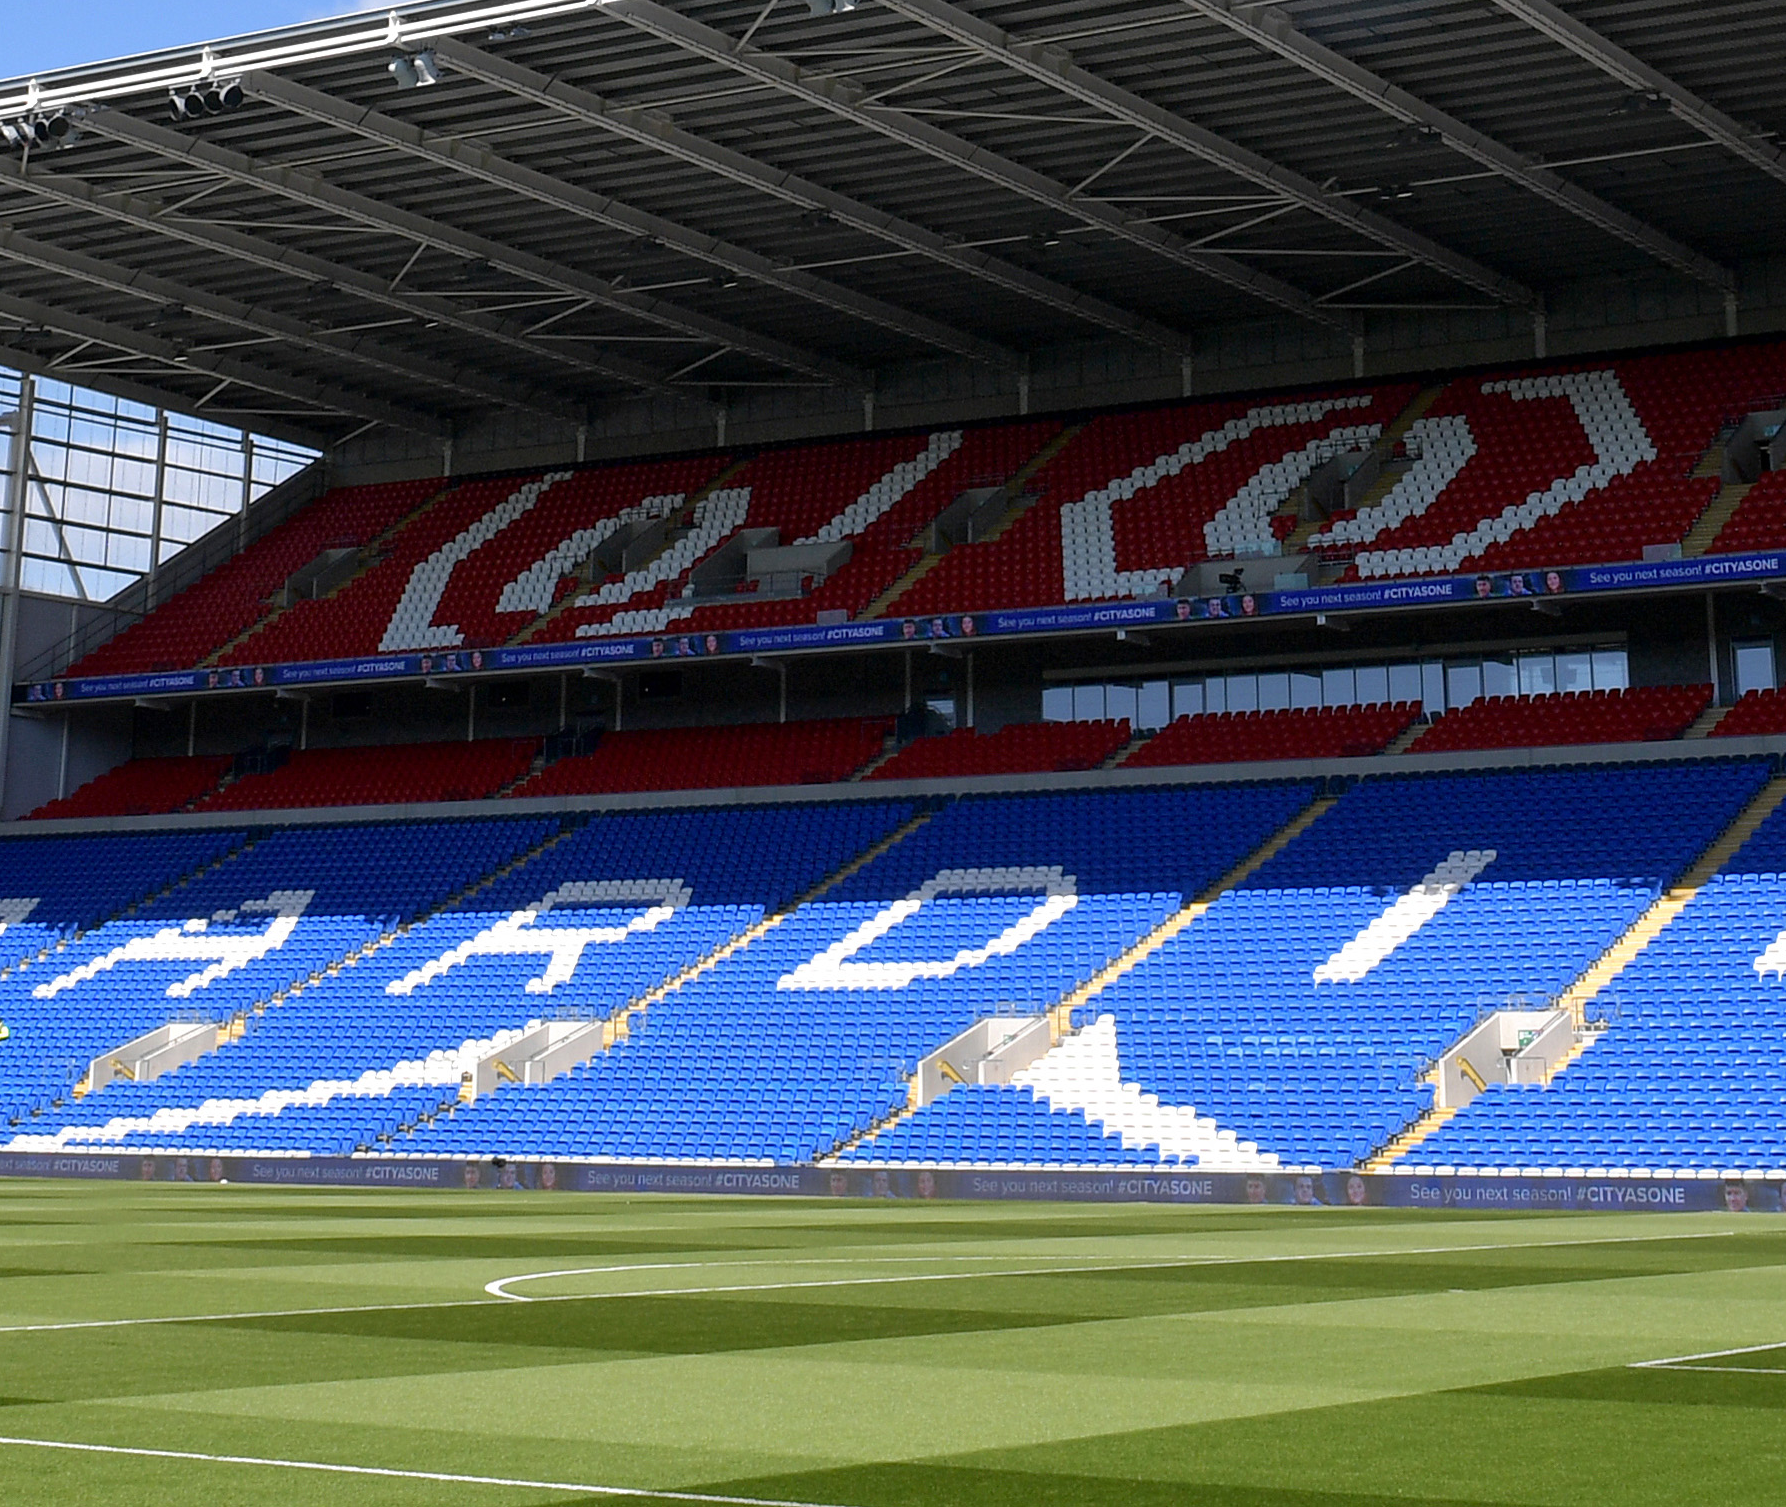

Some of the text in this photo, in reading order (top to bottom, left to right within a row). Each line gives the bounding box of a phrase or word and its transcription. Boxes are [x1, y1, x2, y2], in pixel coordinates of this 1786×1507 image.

[1590, 559, 1778, 584] See you next season! #CITYASONE
[1281, 584, 1452, 607] See you next season! #CITYASONE
[1094, 607, 1155, 622] #CITYASONE
[827, 627, 883, 639] #CITYASONE
[581, 645, 634, 657] #CITYASONE
[357, 662, 405, 673] #CITYASONE
[54, 1159, 119, 1172] #CITYASONE
[253, 1166, 438, 1181] See you next season! #CITYASONE
[588, 1172, 799, 1188] See you next season! #CITYASONE
[973, 1178, 1212, 1195] See you next season! #CITYASONE
[1411, 1184, 1685, 1203] See you next season! #CITYASONE
